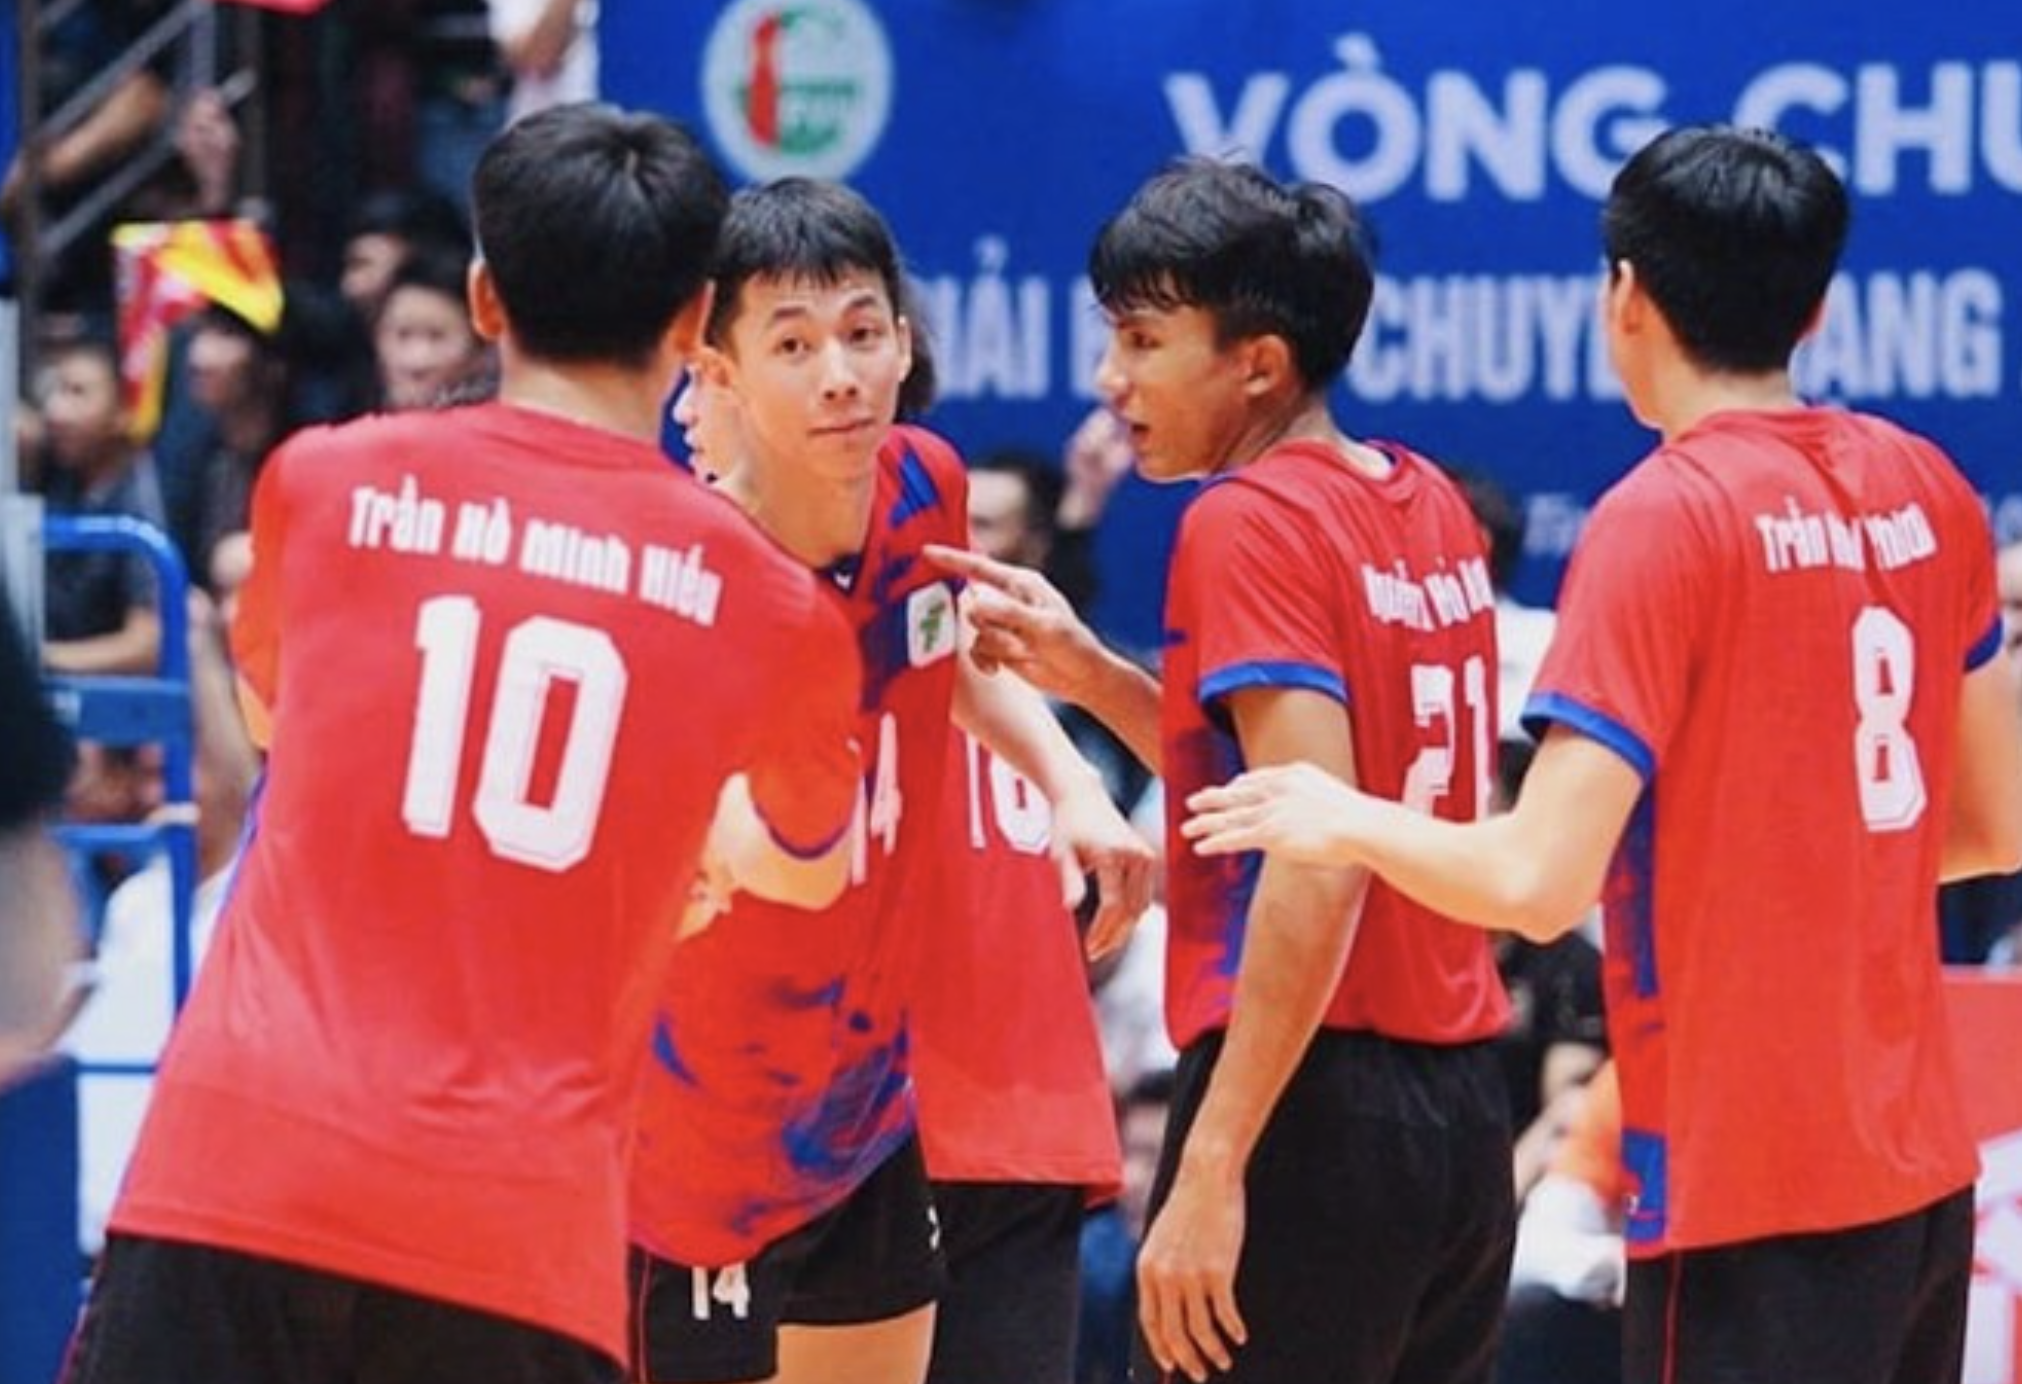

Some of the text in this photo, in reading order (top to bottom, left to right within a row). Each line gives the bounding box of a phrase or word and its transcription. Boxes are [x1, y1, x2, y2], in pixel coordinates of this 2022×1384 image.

[1164, 32, 1670, 201] VÒNG
[906, 234, 1050, 398] IẢI
[402, 594, 629, 874] 10
[1402, 655, 1492, 820] 21
[1852, 605, 1929, 834] 8
[691, 1262, 751, 1321] 14
